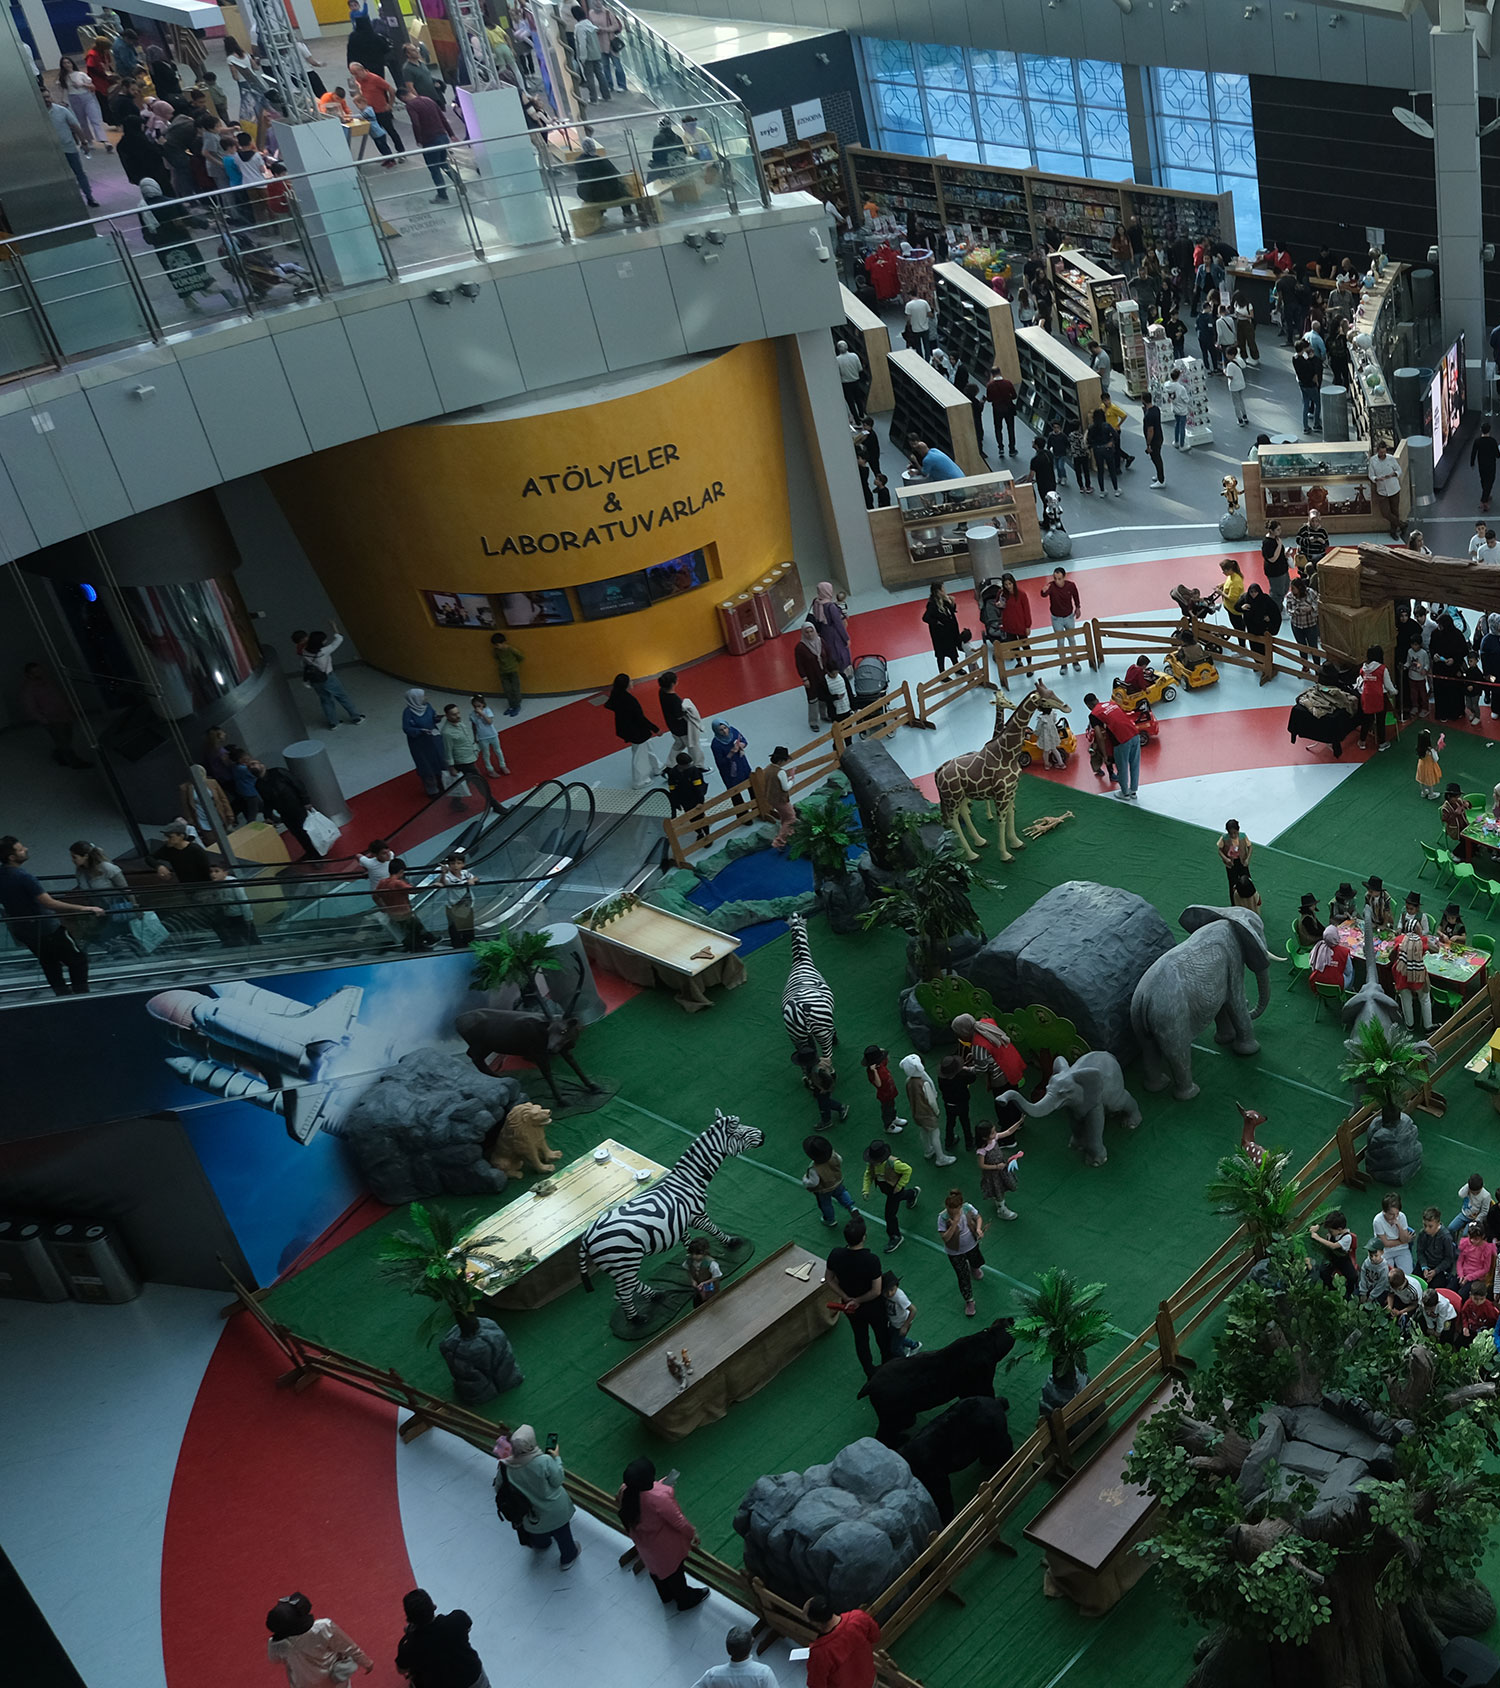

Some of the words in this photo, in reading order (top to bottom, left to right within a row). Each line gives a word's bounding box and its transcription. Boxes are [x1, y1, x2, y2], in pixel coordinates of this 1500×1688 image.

[522, 444, 680, 497] ATÖLYELER
[481, 481, 726, 556] LABORATUVARLAR
[603, 492, 623, 513] &
